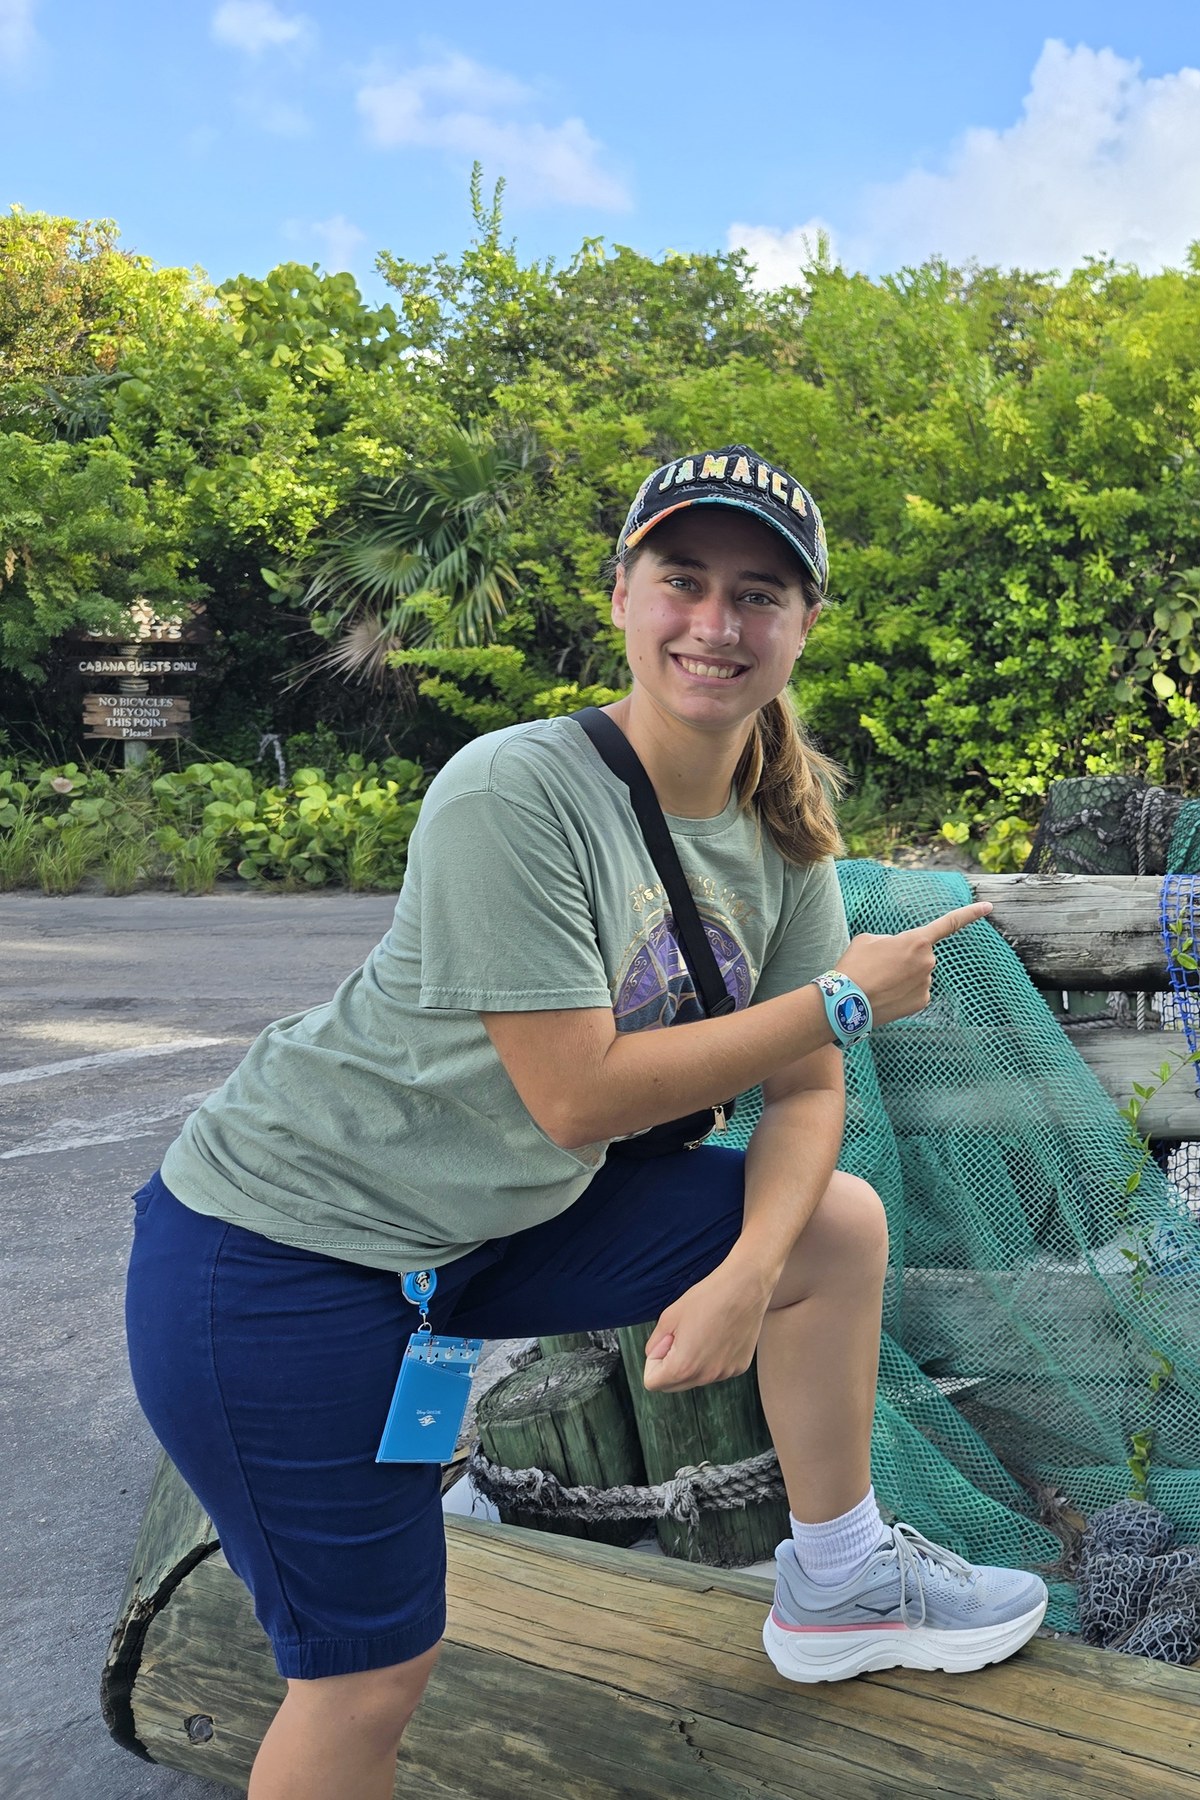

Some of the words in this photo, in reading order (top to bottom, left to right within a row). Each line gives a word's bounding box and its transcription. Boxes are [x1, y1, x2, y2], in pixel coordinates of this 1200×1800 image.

[658, 454, 808, 518] JAMAICA
[79, 661, 126, 672] CABANA
[126, 661, 172, 673] GUESTS
[173, 661, 198, 671] ONLY
[98, 697, 117, 706] NO
[120, 697, 174, 708] BICYCLES
[112, 707, 160, 717] BEYOND
[105, 718, 132, 728] THIS
[133, 718, 168, 728] POINT
